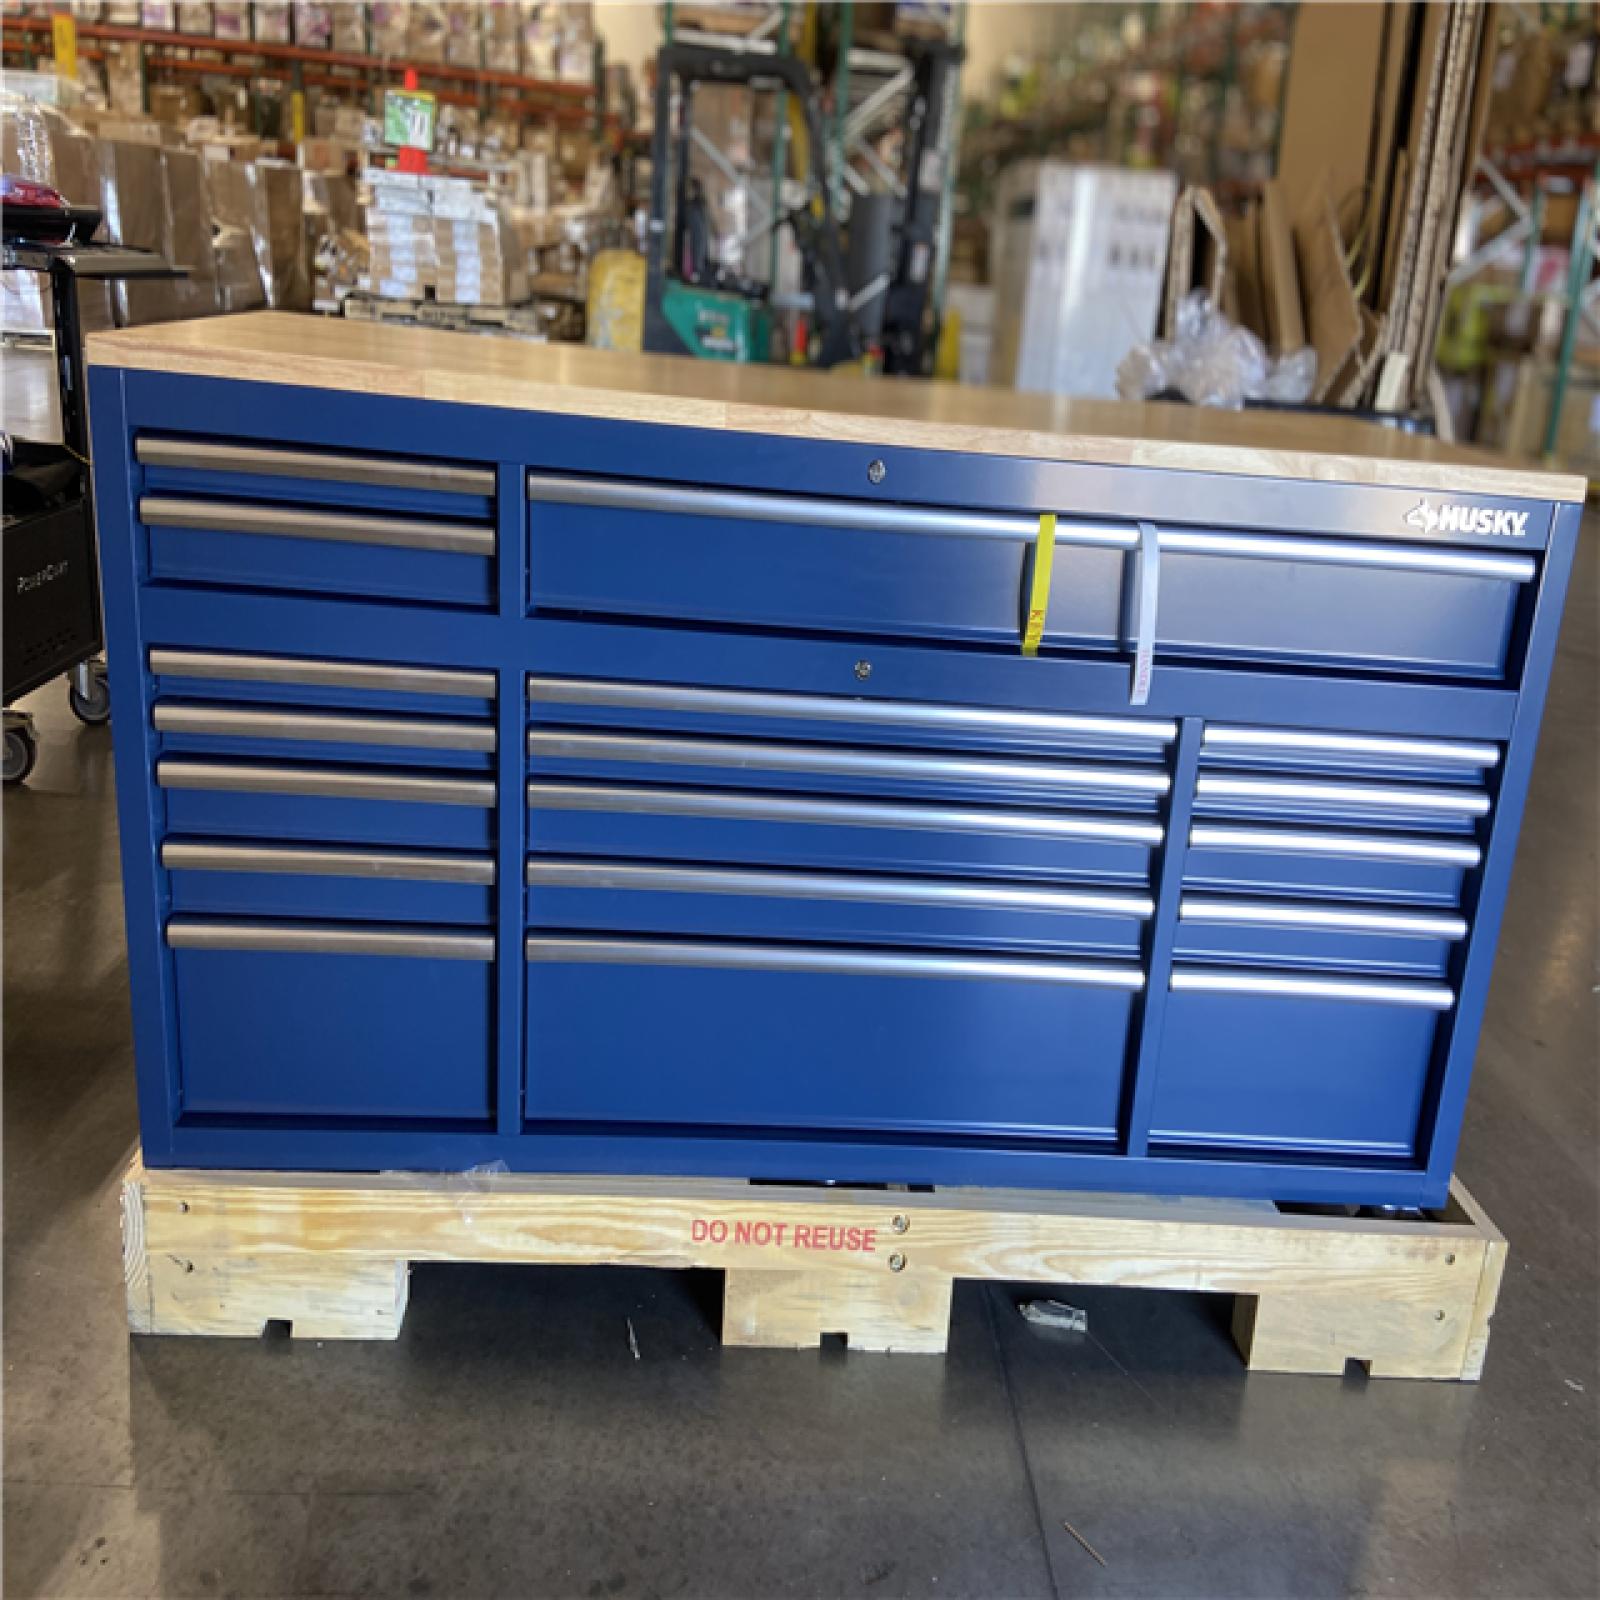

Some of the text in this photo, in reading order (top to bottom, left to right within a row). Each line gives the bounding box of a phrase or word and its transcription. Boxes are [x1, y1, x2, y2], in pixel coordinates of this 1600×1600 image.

[1439, 504, 1530, 536] HUSKY
[691, 1219, 877, 1251] DO NOT REUSE
